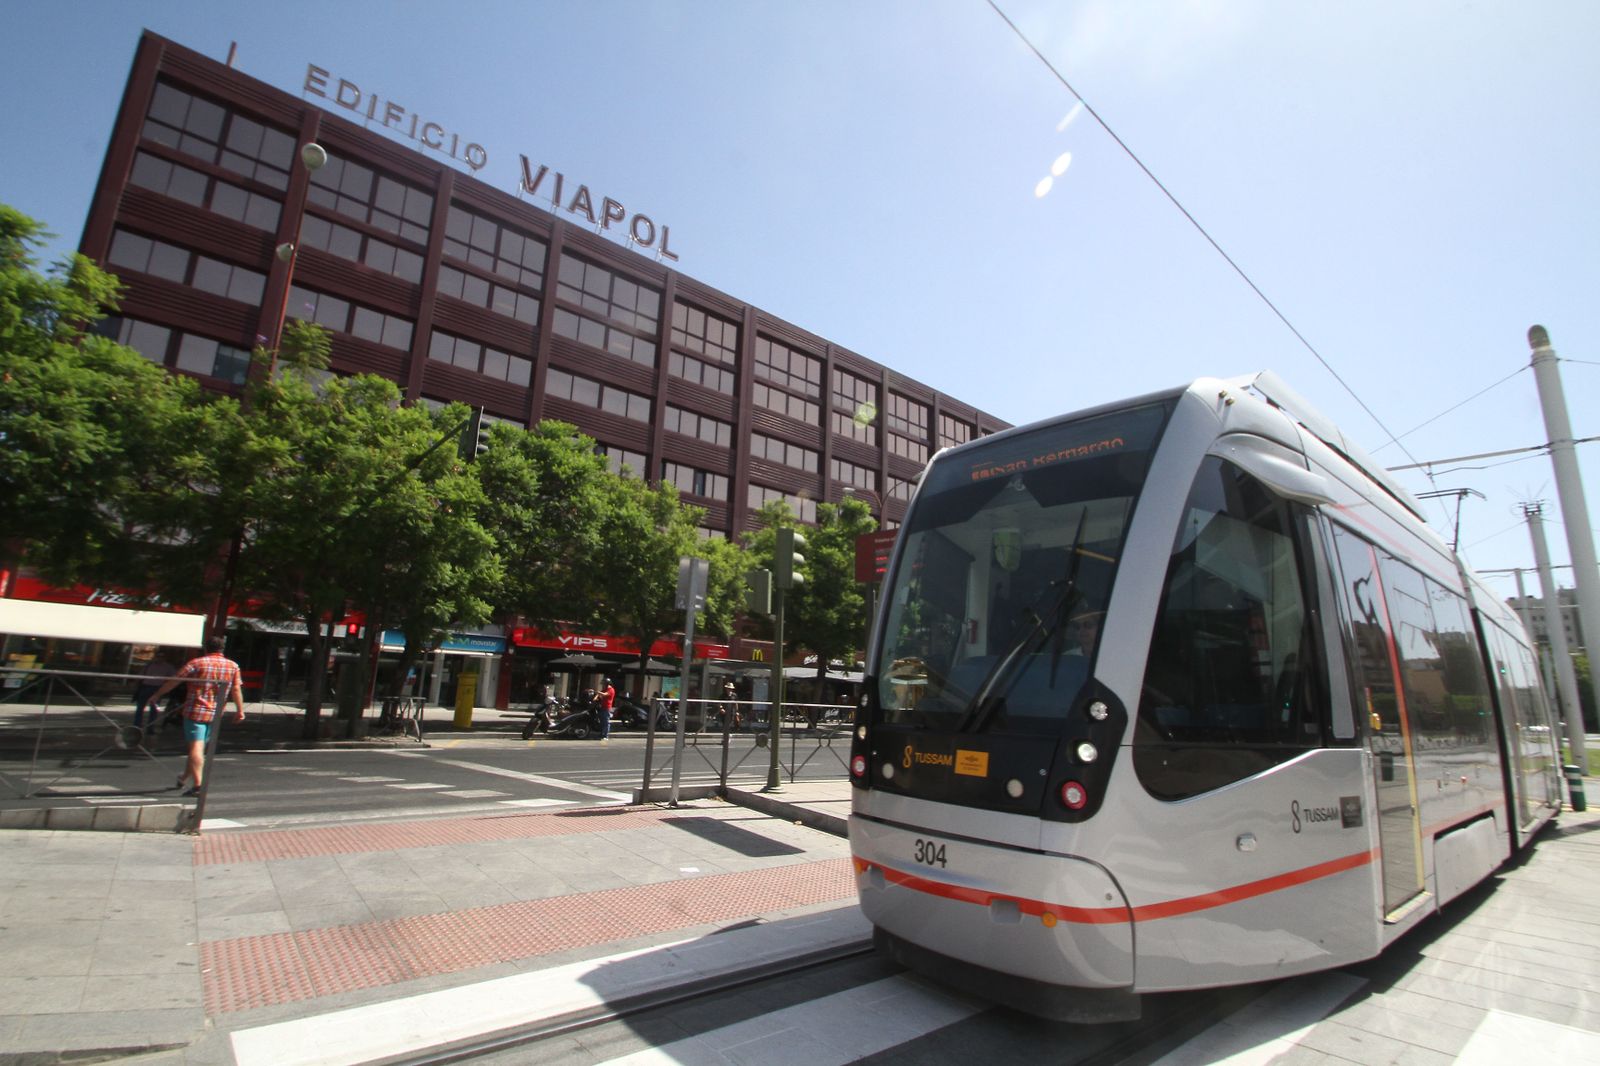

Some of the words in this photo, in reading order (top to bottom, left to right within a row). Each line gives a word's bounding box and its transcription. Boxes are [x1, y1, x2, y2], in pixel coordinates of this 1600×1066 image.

[304, 64, 488, 171] EDIFICIO
[519, 153, 680, 261] VIAPOL
[470, 640, 497, 648] movistar
[558, 636, 608, 648] VIPS
[915, 752, 953, 766] TUSSAM
[1304, 807, 1339, 822] TUSSAM
[915, 839, 947, 868] 304
